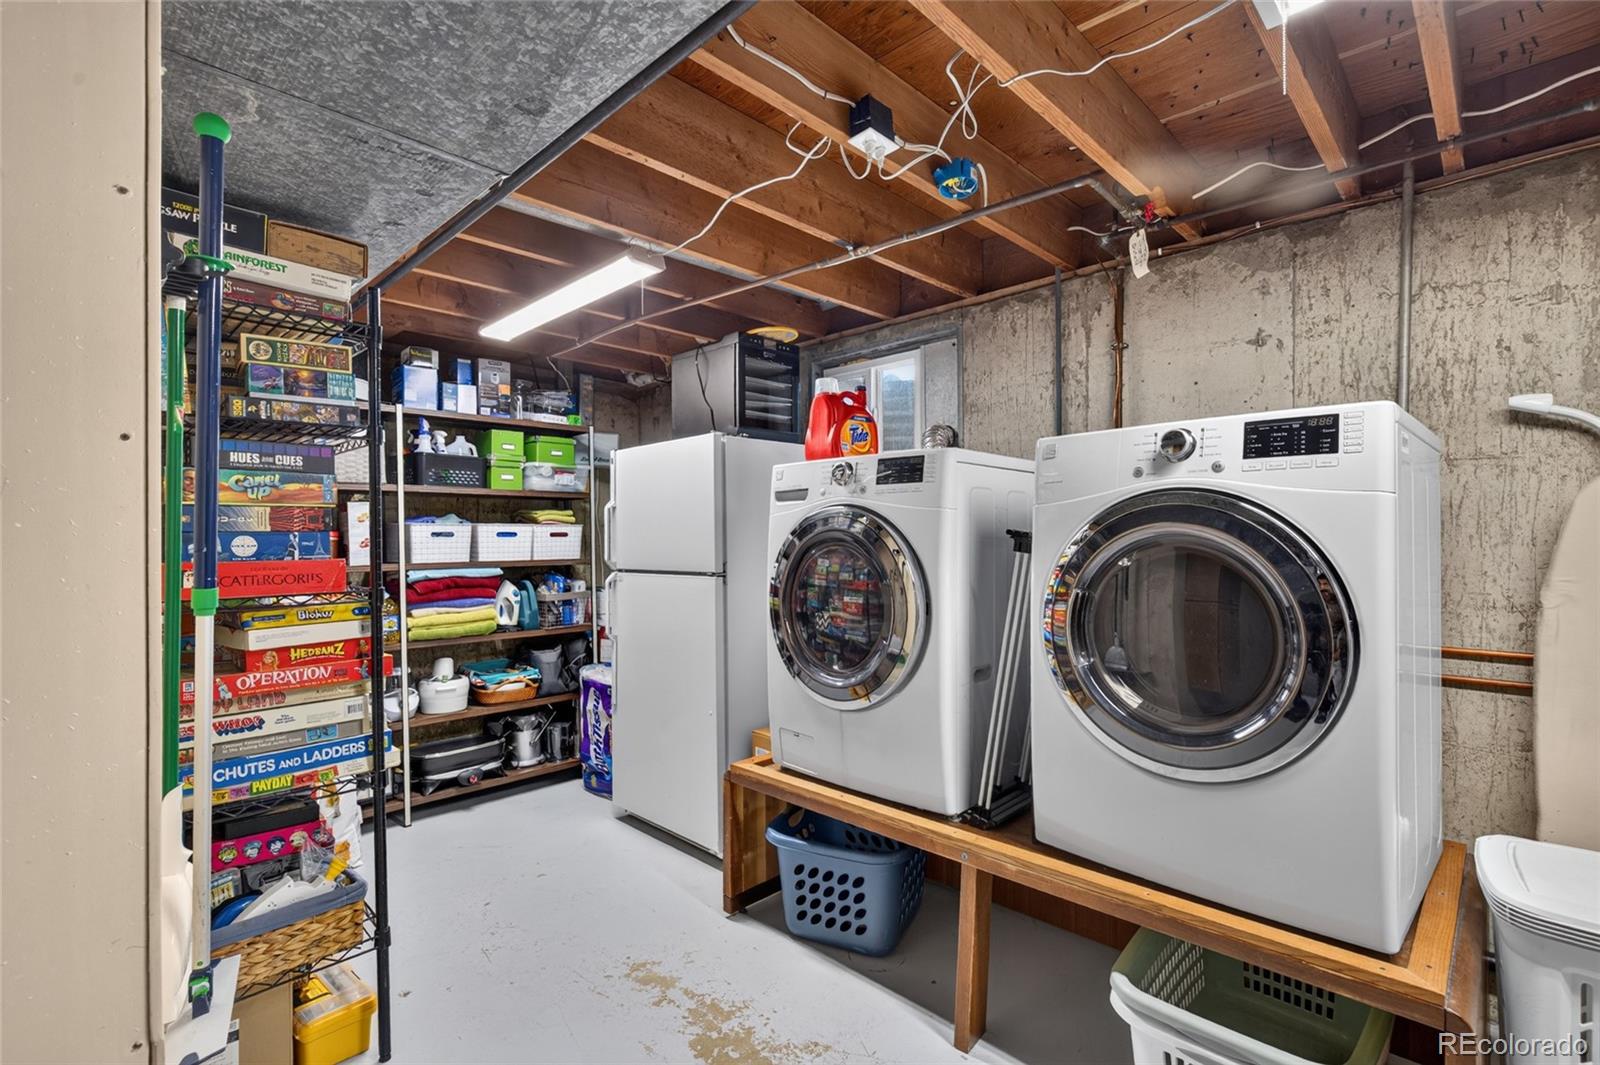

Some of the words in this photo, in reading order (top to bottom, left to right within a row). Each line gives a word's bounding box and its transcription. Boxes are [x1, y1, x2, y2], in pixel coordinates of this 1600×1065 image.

[223, 251, 288, 273] AINFOREST
[849, 424, 869, 446] Tide
[229, 451, 260, 464] HUES
[275, 455, 304, 467] CUES
[218, 573, 323, 588] CATTERGORIES
[297, 609, 335, 620] Blokus
[236, 665, 333, 690] OPERATION
[212, 759, 276, 783] CHUTES
[278, 758, 301, 770] AND
[303, 740, 367, 765] LADDERS
[252, 773, 294, 793] PAYDAY
